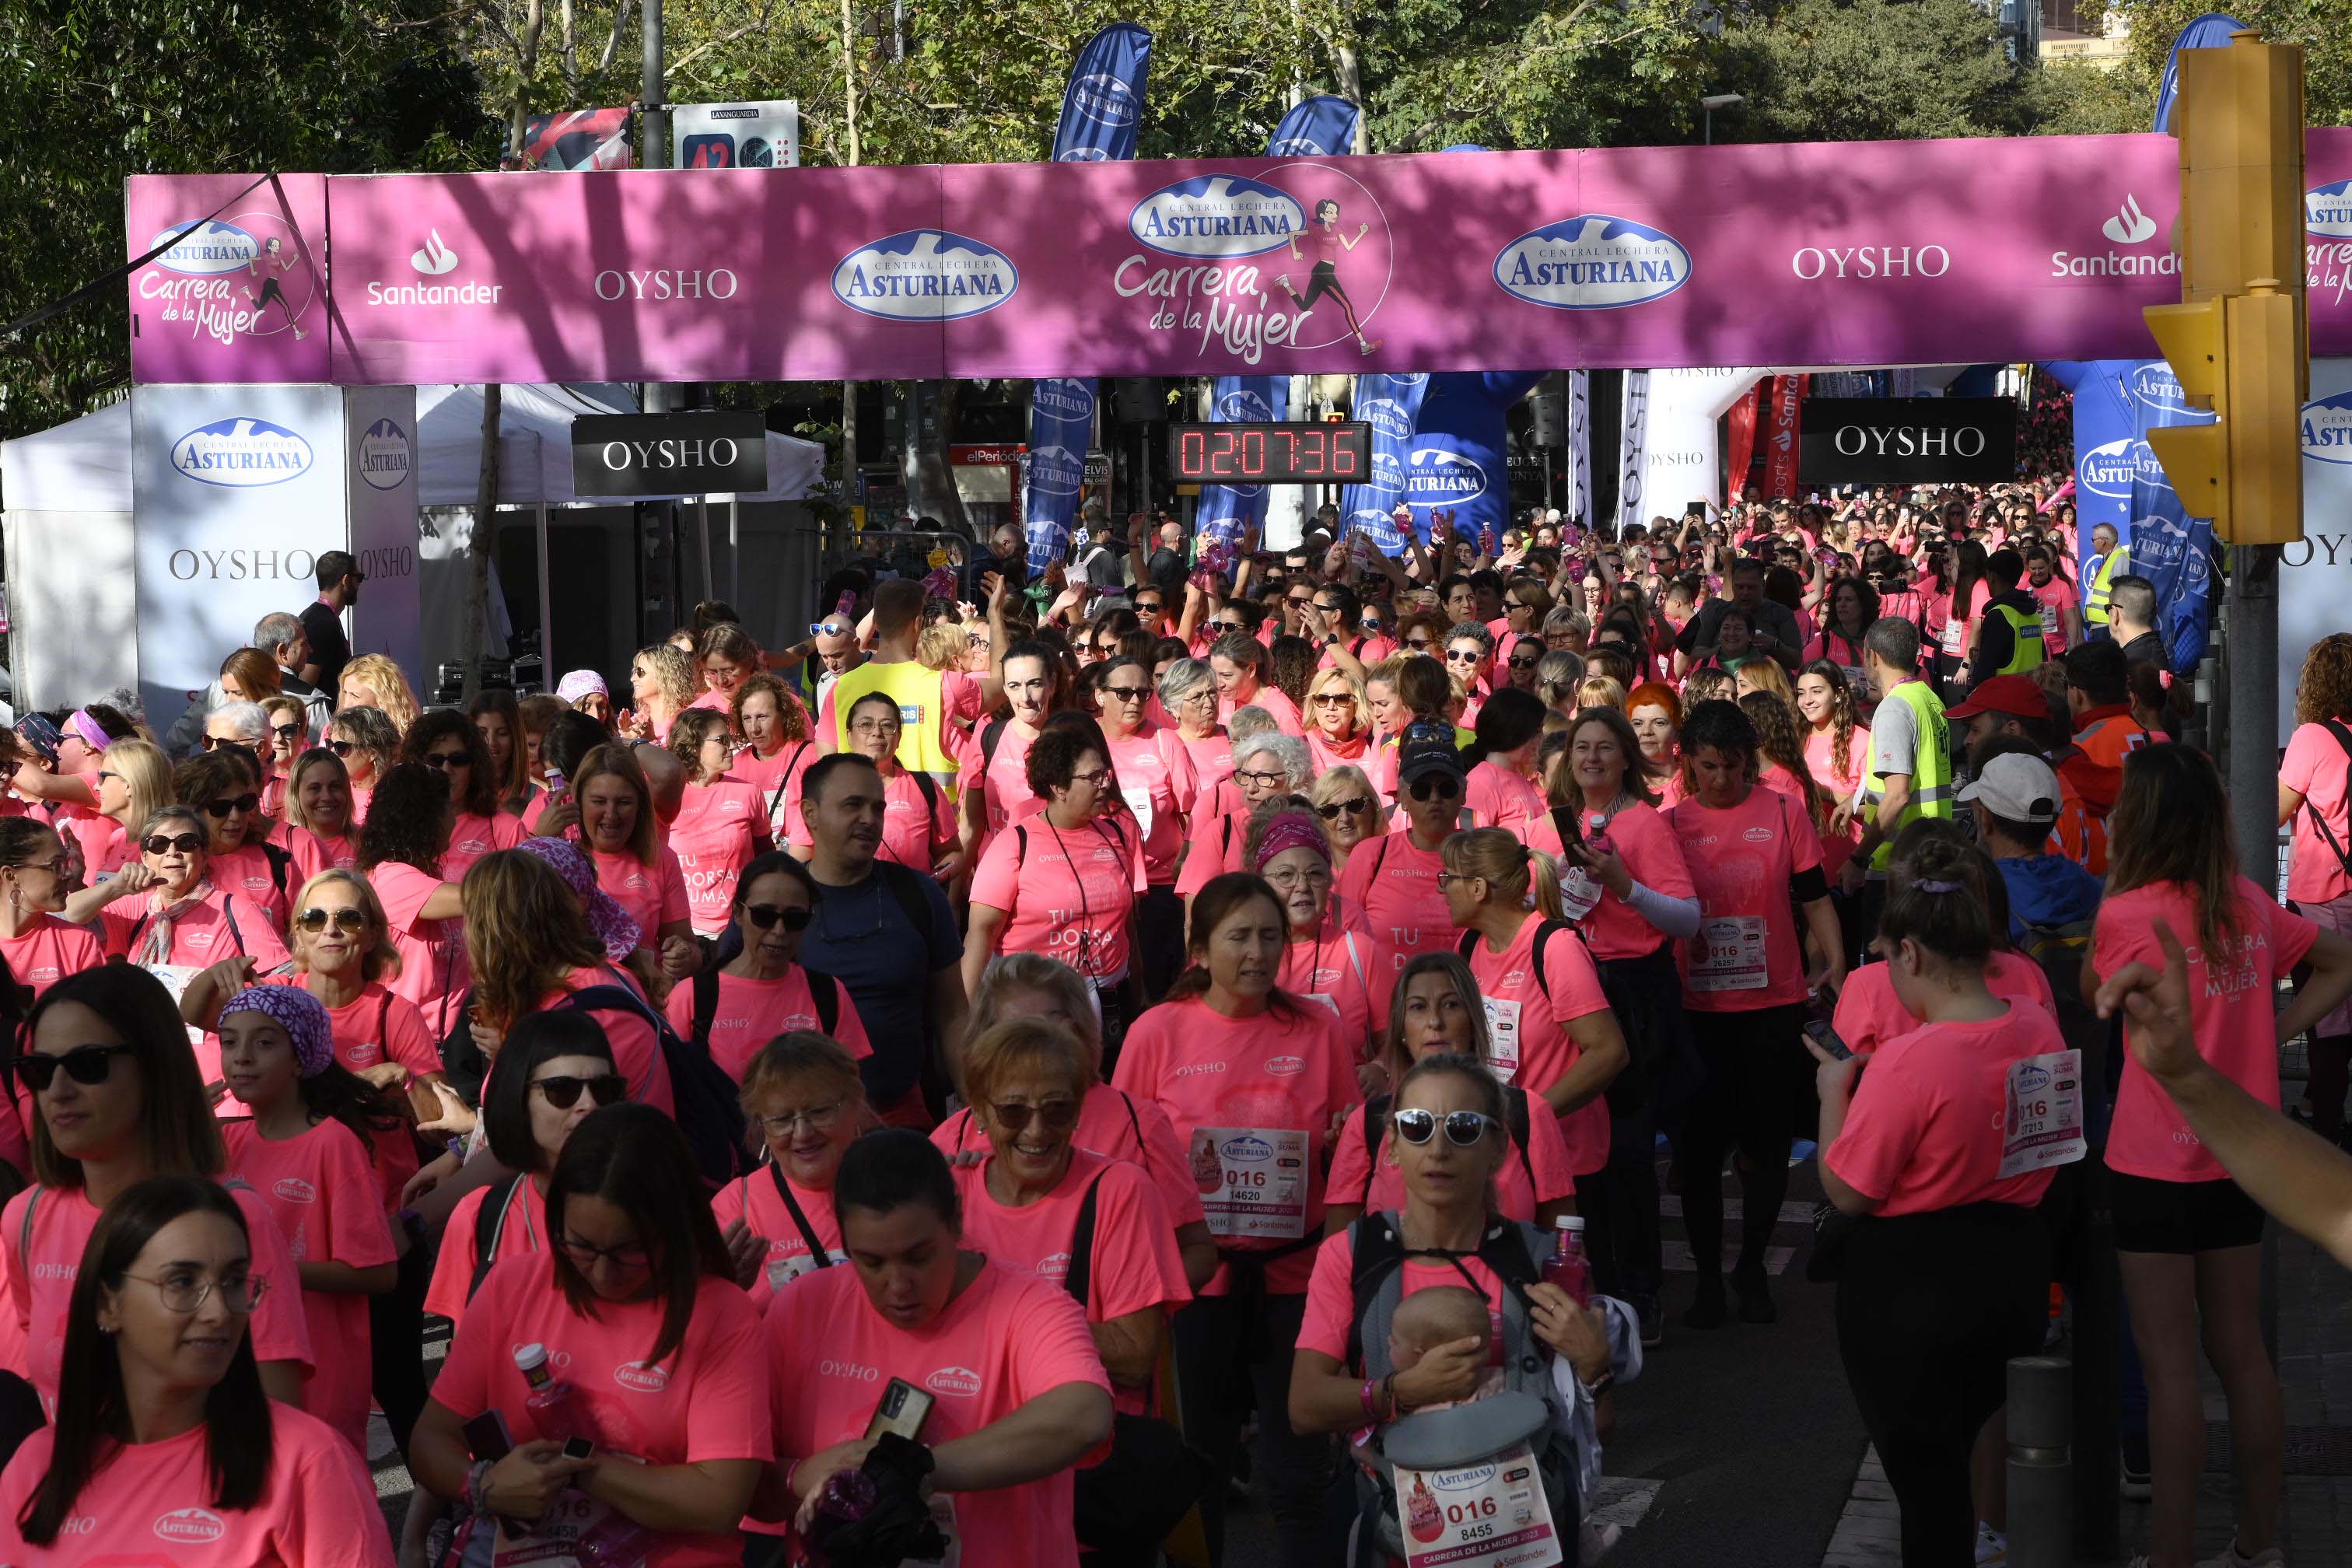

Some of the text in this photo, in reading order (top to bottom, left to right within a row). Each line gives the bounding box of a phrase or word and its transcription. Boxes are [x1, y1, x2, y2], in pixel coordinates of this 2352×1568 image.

[1170, 201, 1287, 212] CENTRAL LECHERA
[1143, 205, 1291, 238] ASTURIANA
[1539, 246, 1670, 258] CENTRAL LECHERA
[874, 260, 998, 271] CENTRAL LECHERA
[1508, 251, 1676, 286] ASTURIANA
[1792, 245, 1950, 280] OYSHO
[2052, 250, 2182, 277] Santand
[139, 270, 231, 299] Carrera
[595, 268, 738, 301] OYSHO
[846, 264, 1005, 298] ASTURIANA
[1115, 254, 1260, 299] Carrera
[367, 281, 503, 306] Santander
[162, 296, 266, 346] de la Mujer
[1150, 292, 1314, 366] de la Mujer
[2322, 415, 2352, 424] CENT
[1834, 425, 1986, 458] OYSHO
[182, 443, 303, 470] ASTURIANA
[362, 444, 408, 473] ASTURIANA
[603, 437, 738, 471] OYSHO
[967, 450, 1021, 462] elPeriódi
[1181, 431, 1355, 474] 02:07:36
[1031, 466, 1081, 486] STURIANA
[1084, 464, 1108, 476] ELVIS
[2086, 461, 2133, 484] ASTU
[1409, 476, 1480, 492] TURIANA
[1355, 523, 1402, 544] STURIANA
[2280, 534, 2352, 567] OY
[169, 548, 316, 580] OYSHO
[361, 545, 412, 580] OYSHO
[679, 806, 700, 817] YSHO
[1685, 835, 1718, 848] OYSHO
[691, 889, 729, 904] UMA
[1048, 908, 1074, 926] TU
[1390, 927, 1419, 945] TU
[1712, 945, 1738, 957] 016
[1713, 959, 1735, 968] 26257
[2205, 971, 2259, 998] MUJER
[712, 1017, 749, 1030] YSHO
[1176, 1061, 1227, 1077] OYSHO
[1266, 1062, 1305, 1074] ASTURIANA
[2172, 1132, 2200, 1145] OYS
[1225, 1145, 1270, 1157] ASTURIANA
[1226, 1169, 1266, 1187] 016
[1230, 1190, 1260, 1202] 14620
[1437, 1467, 1493, 1487] ASTURIANA
[1447, 1496, 1497, 1524] 016
[159, 1519, 221, 1535] ASTURIANA
[1461, 1523, 1493, 1542] 8455
[1424, 1549, 1464, 1564] CARRERA
[1465, 1545, 1477, 1556] DE
[1479, 1542, 1489, 1552] LA
[1491, 1536, 1517, 1549] MUJER
[1504, 1549, 1549, 1568] Santander
